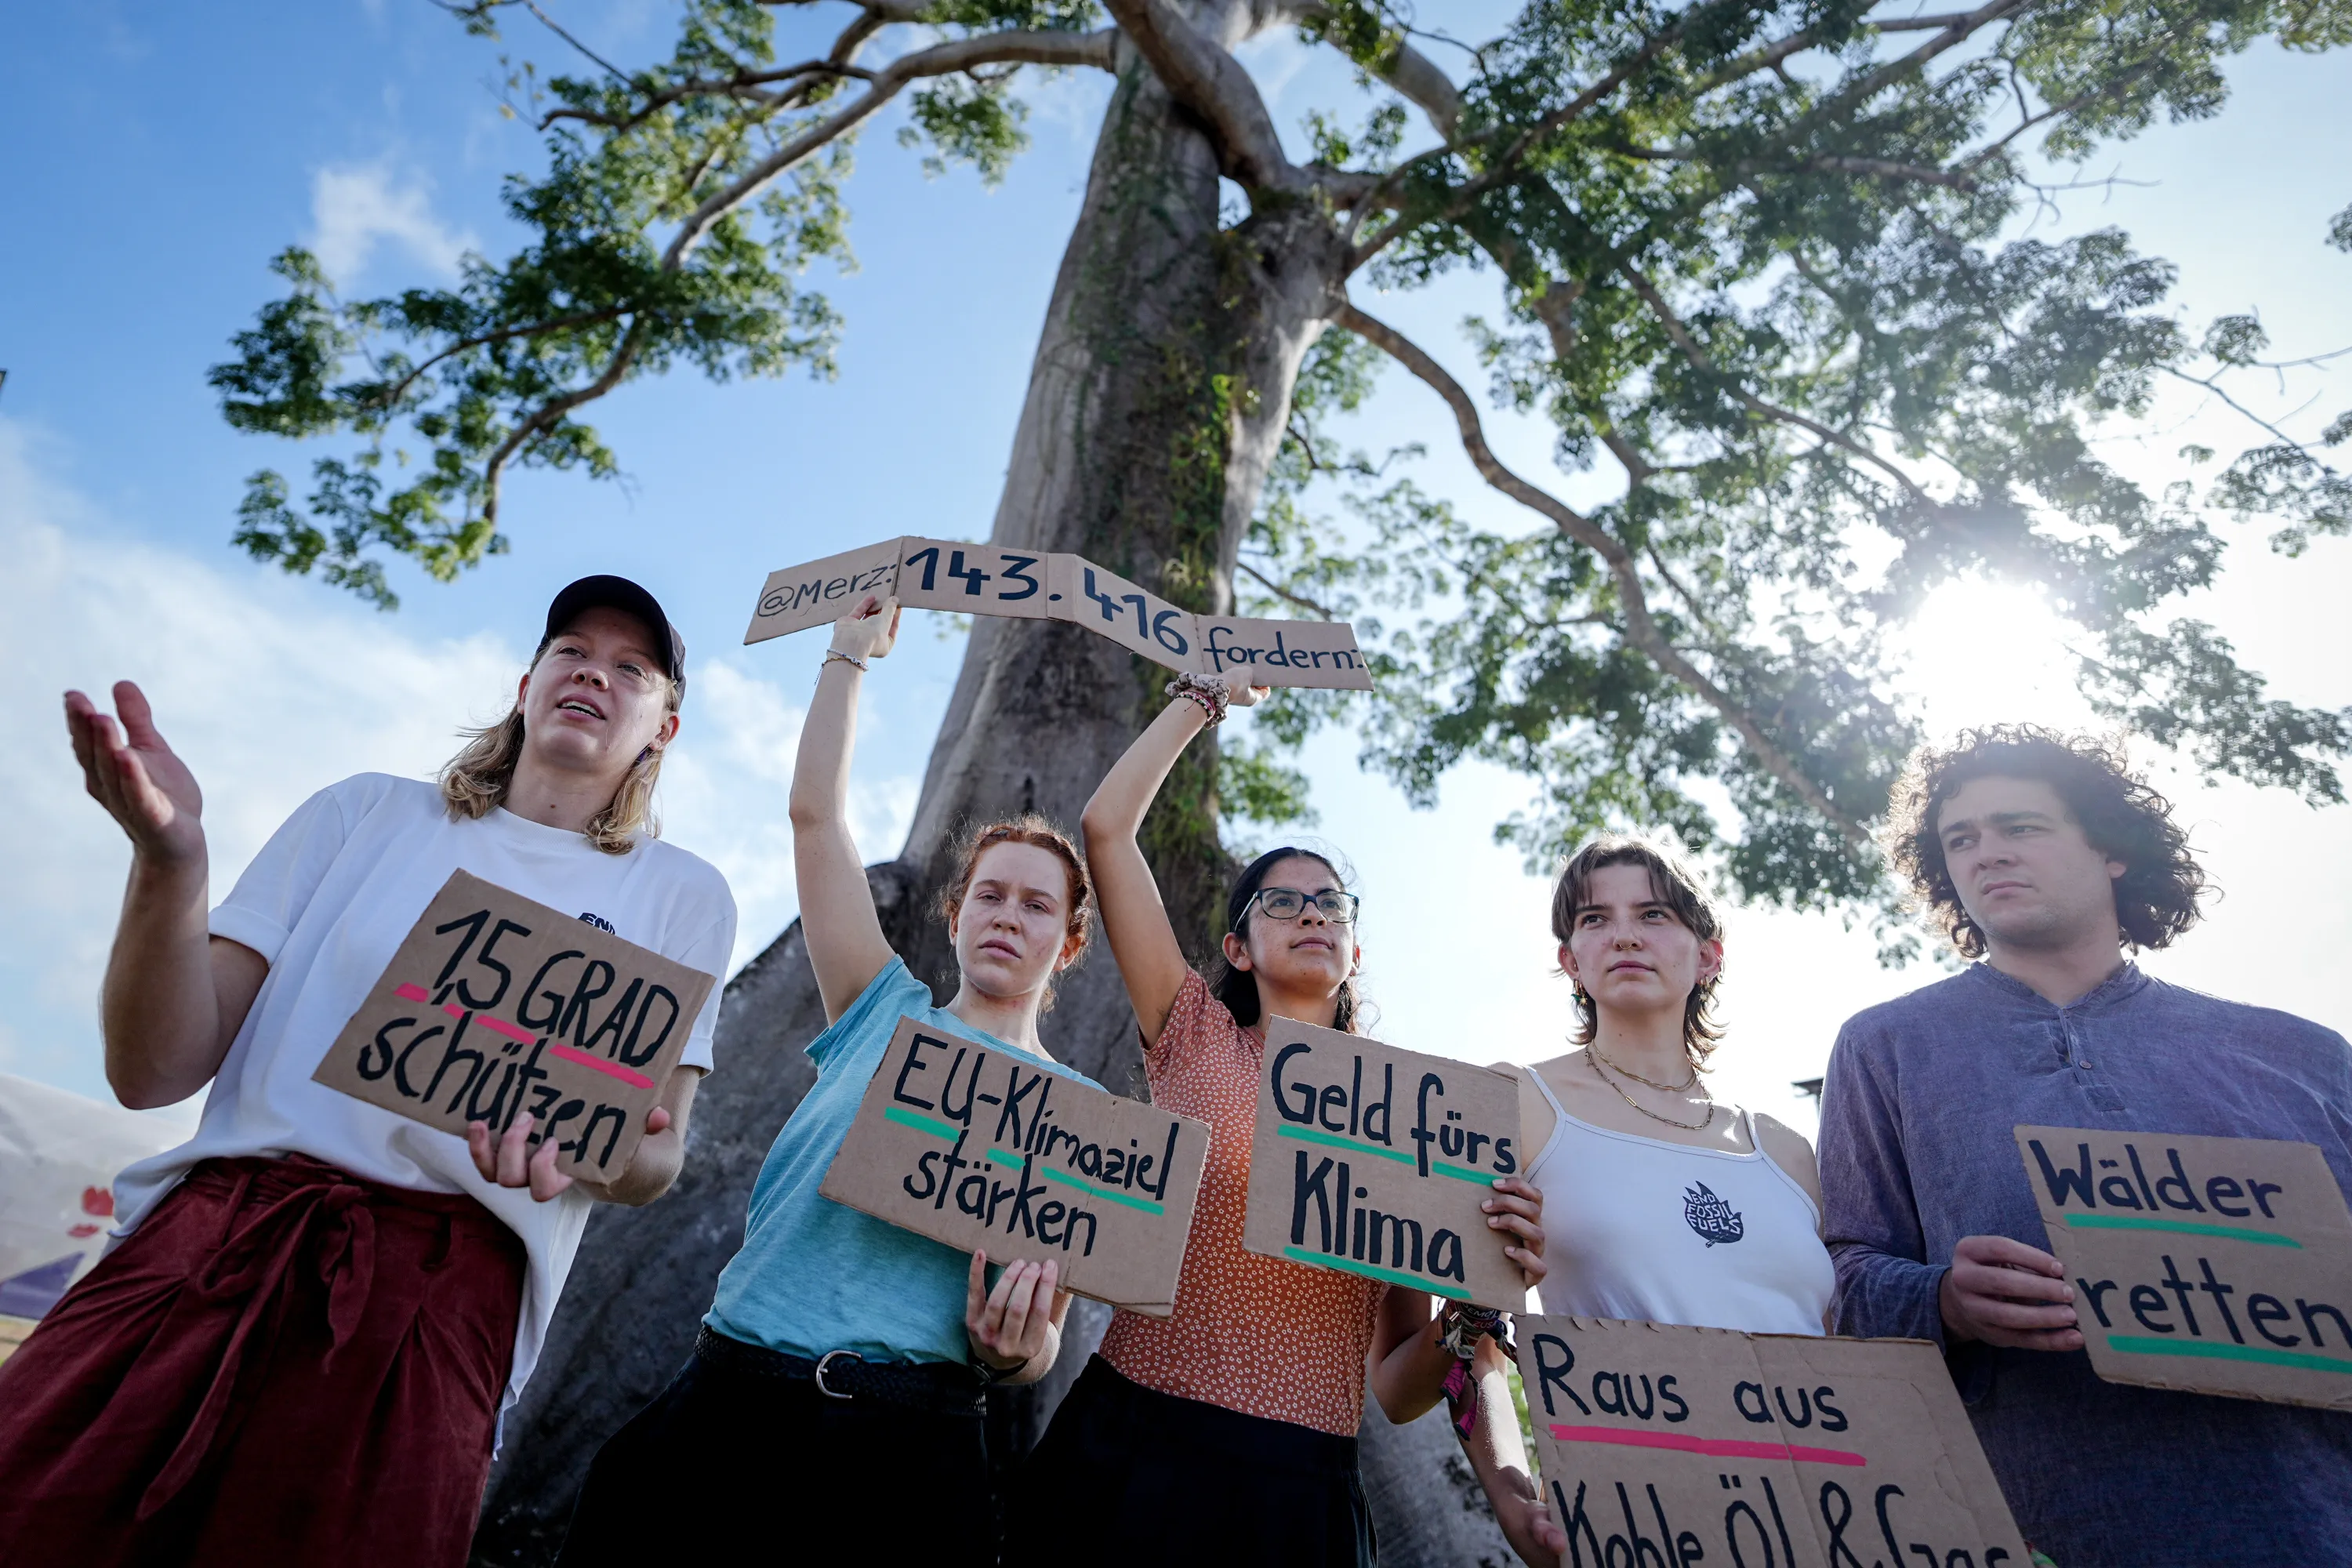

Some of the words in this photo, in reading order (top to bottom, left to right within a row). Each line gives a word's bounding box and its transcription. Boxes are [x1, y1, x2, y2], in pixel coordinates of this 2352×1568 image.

[757, 563, 898, 618] @Merz:
[1203, 626, 1364, 673] fordern:
[430, 909, 532, 1010] 1,5
[516, 949, 680, 1067] GRAD
[356, 1011, 626, 1169] schützen
[893, 1033, 1179, 1200] EU-Klimaziel
[1270, 1043, 1392, 1146] Geld
[1410, 1072, 1516, 1178] fürs
[902, 1129, 1098, 1256] stärken
[1290, 1150, 1465, 1283] Klima
[1686, 1213, 1741, 1235] FUELS
[1687, 1203, 1734, 1220] FOSSIL
[1690, 1193, 1715, 1204] END
[2027, 1139, 2283, 1218] Wälder
[2076, 1254, 2352, 1350] retten
[1532, 1334, 1690, 1423] Raus
[1733, 1380, 1849, 1432] aus
